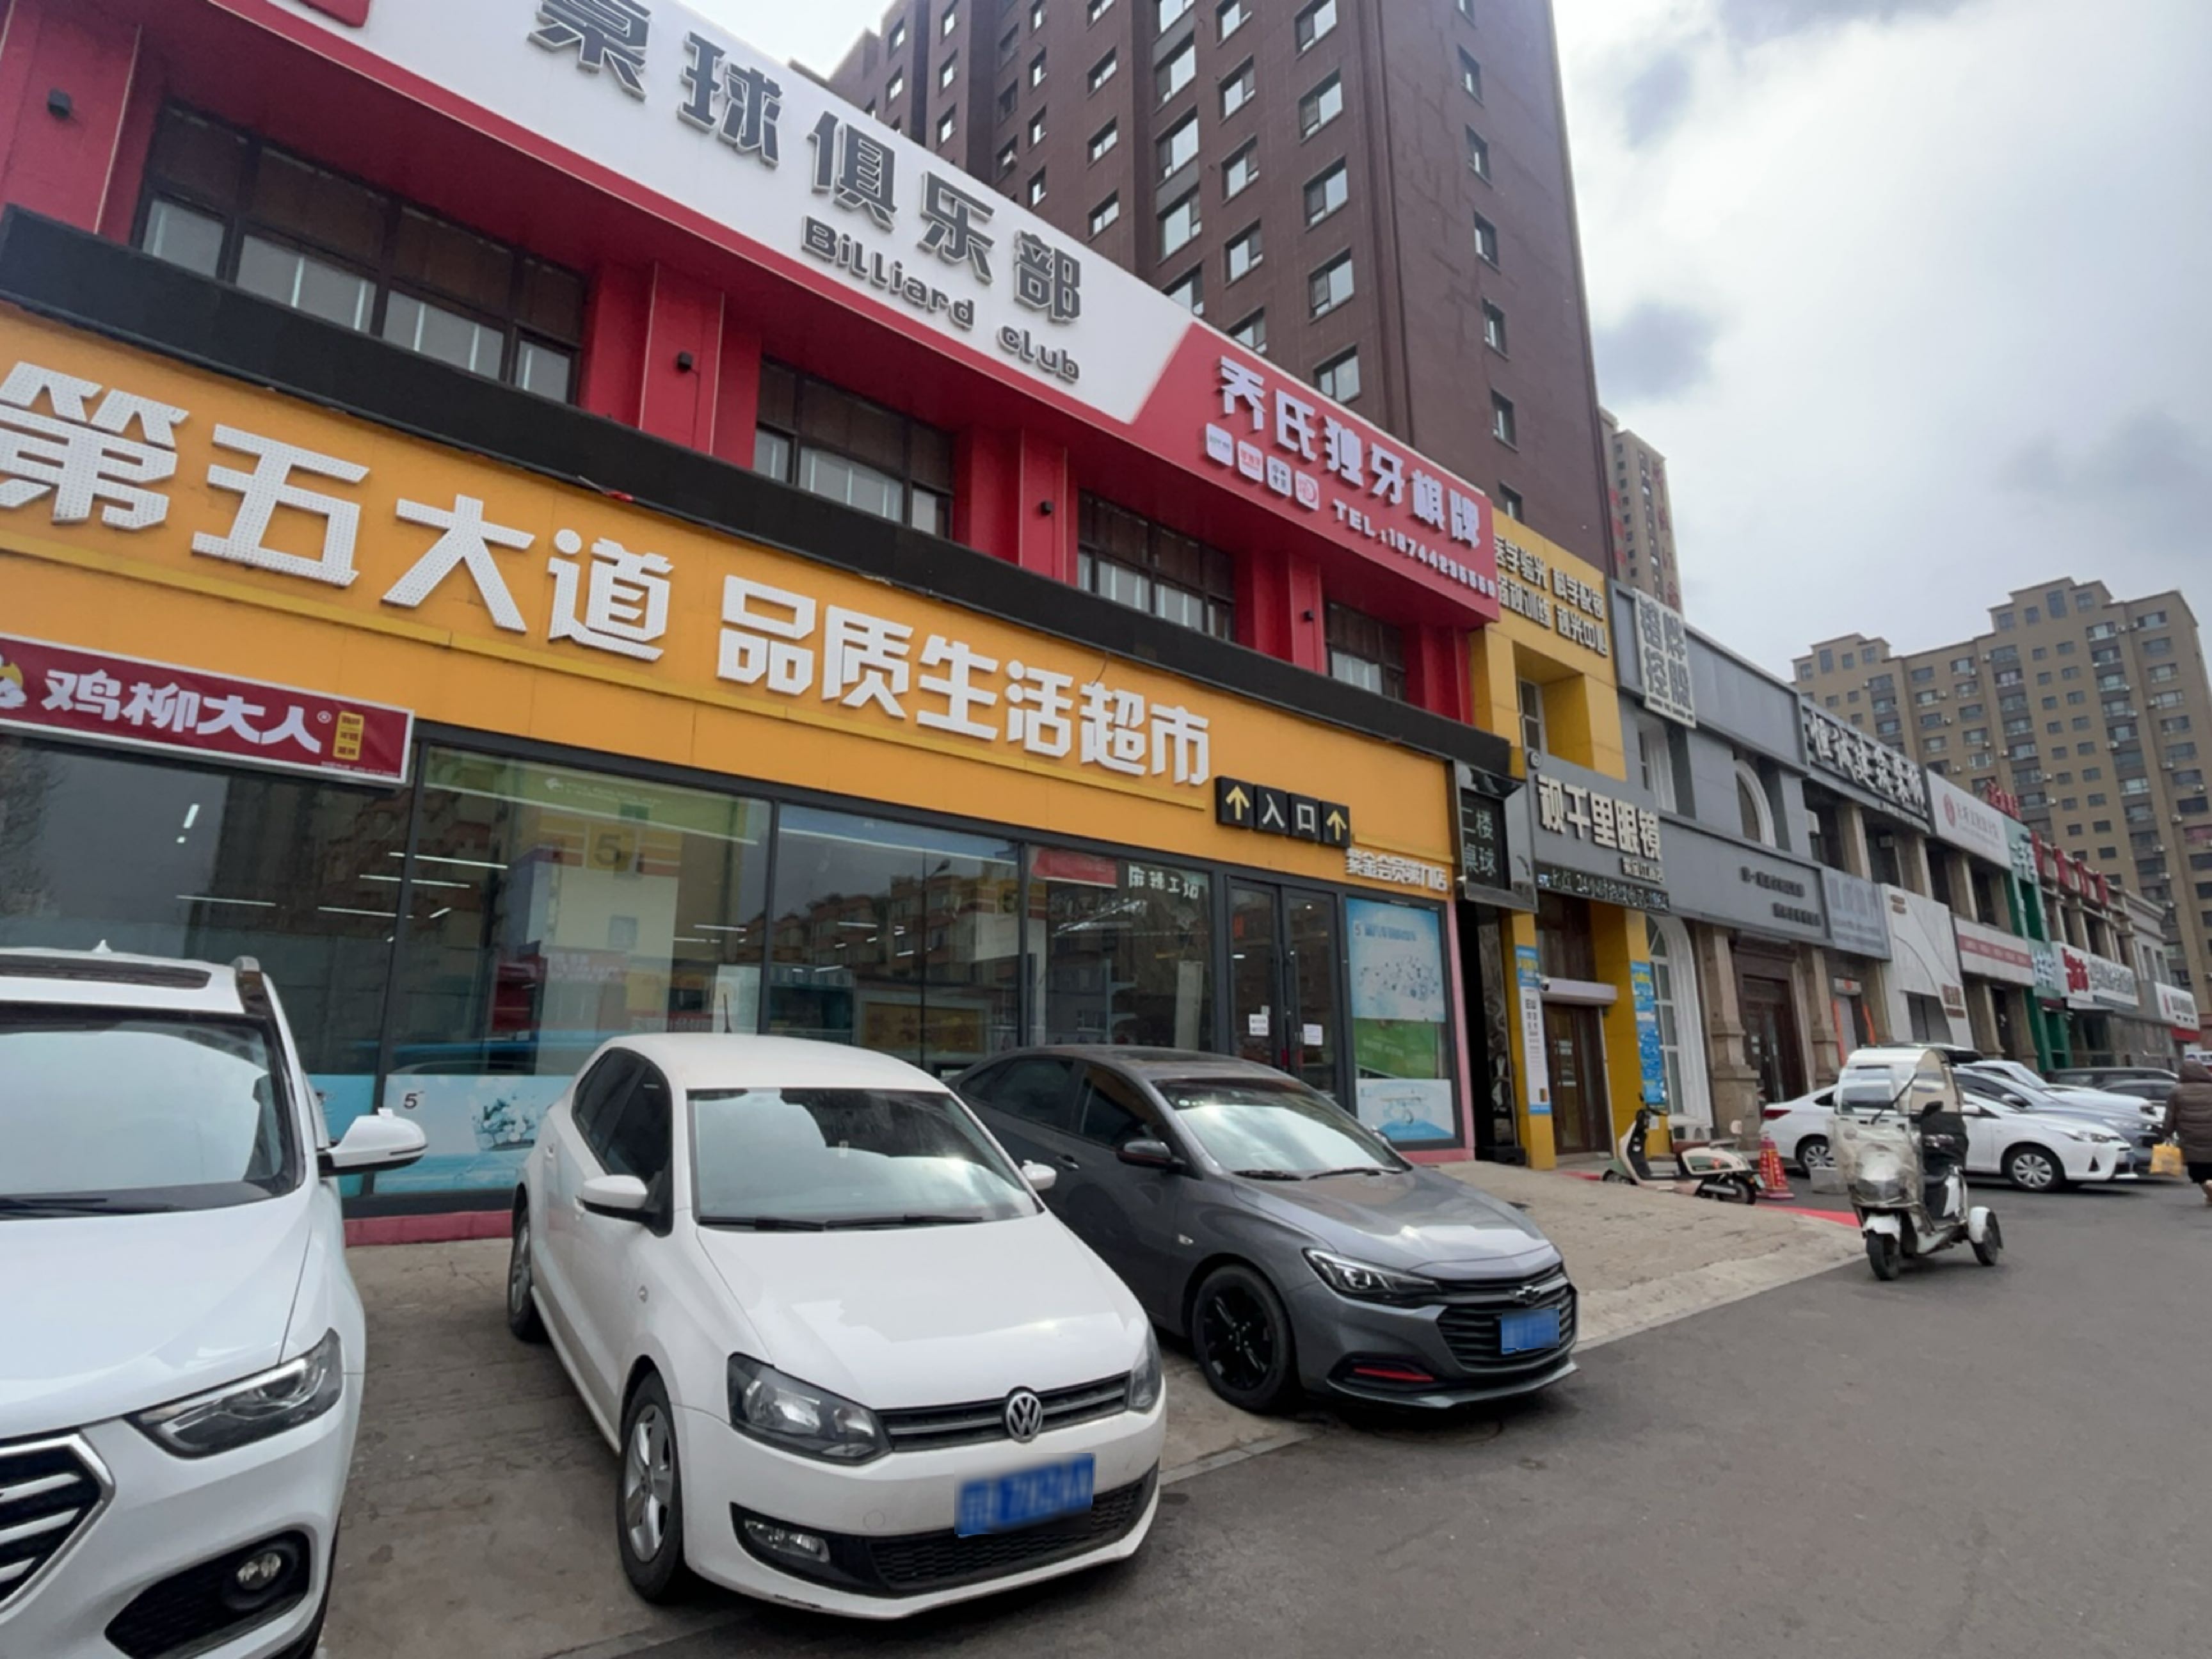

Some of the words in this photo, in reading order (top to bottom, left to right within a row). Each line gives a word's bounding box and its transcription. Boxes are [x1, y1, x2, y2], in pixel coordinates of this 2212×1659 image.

[528, 0, 1082, 323] 桌球俱乐部
[802, 214, 974, 330] Billiard
[997, 325, 1081, 382] club
[0, 361, 674, 661] 第五大道
[717, 575, 1210, 785] 品质生活超市
[42, 669, 321, 754] 鸡柳大人
[1262, 793, 1316, 834] 入口
